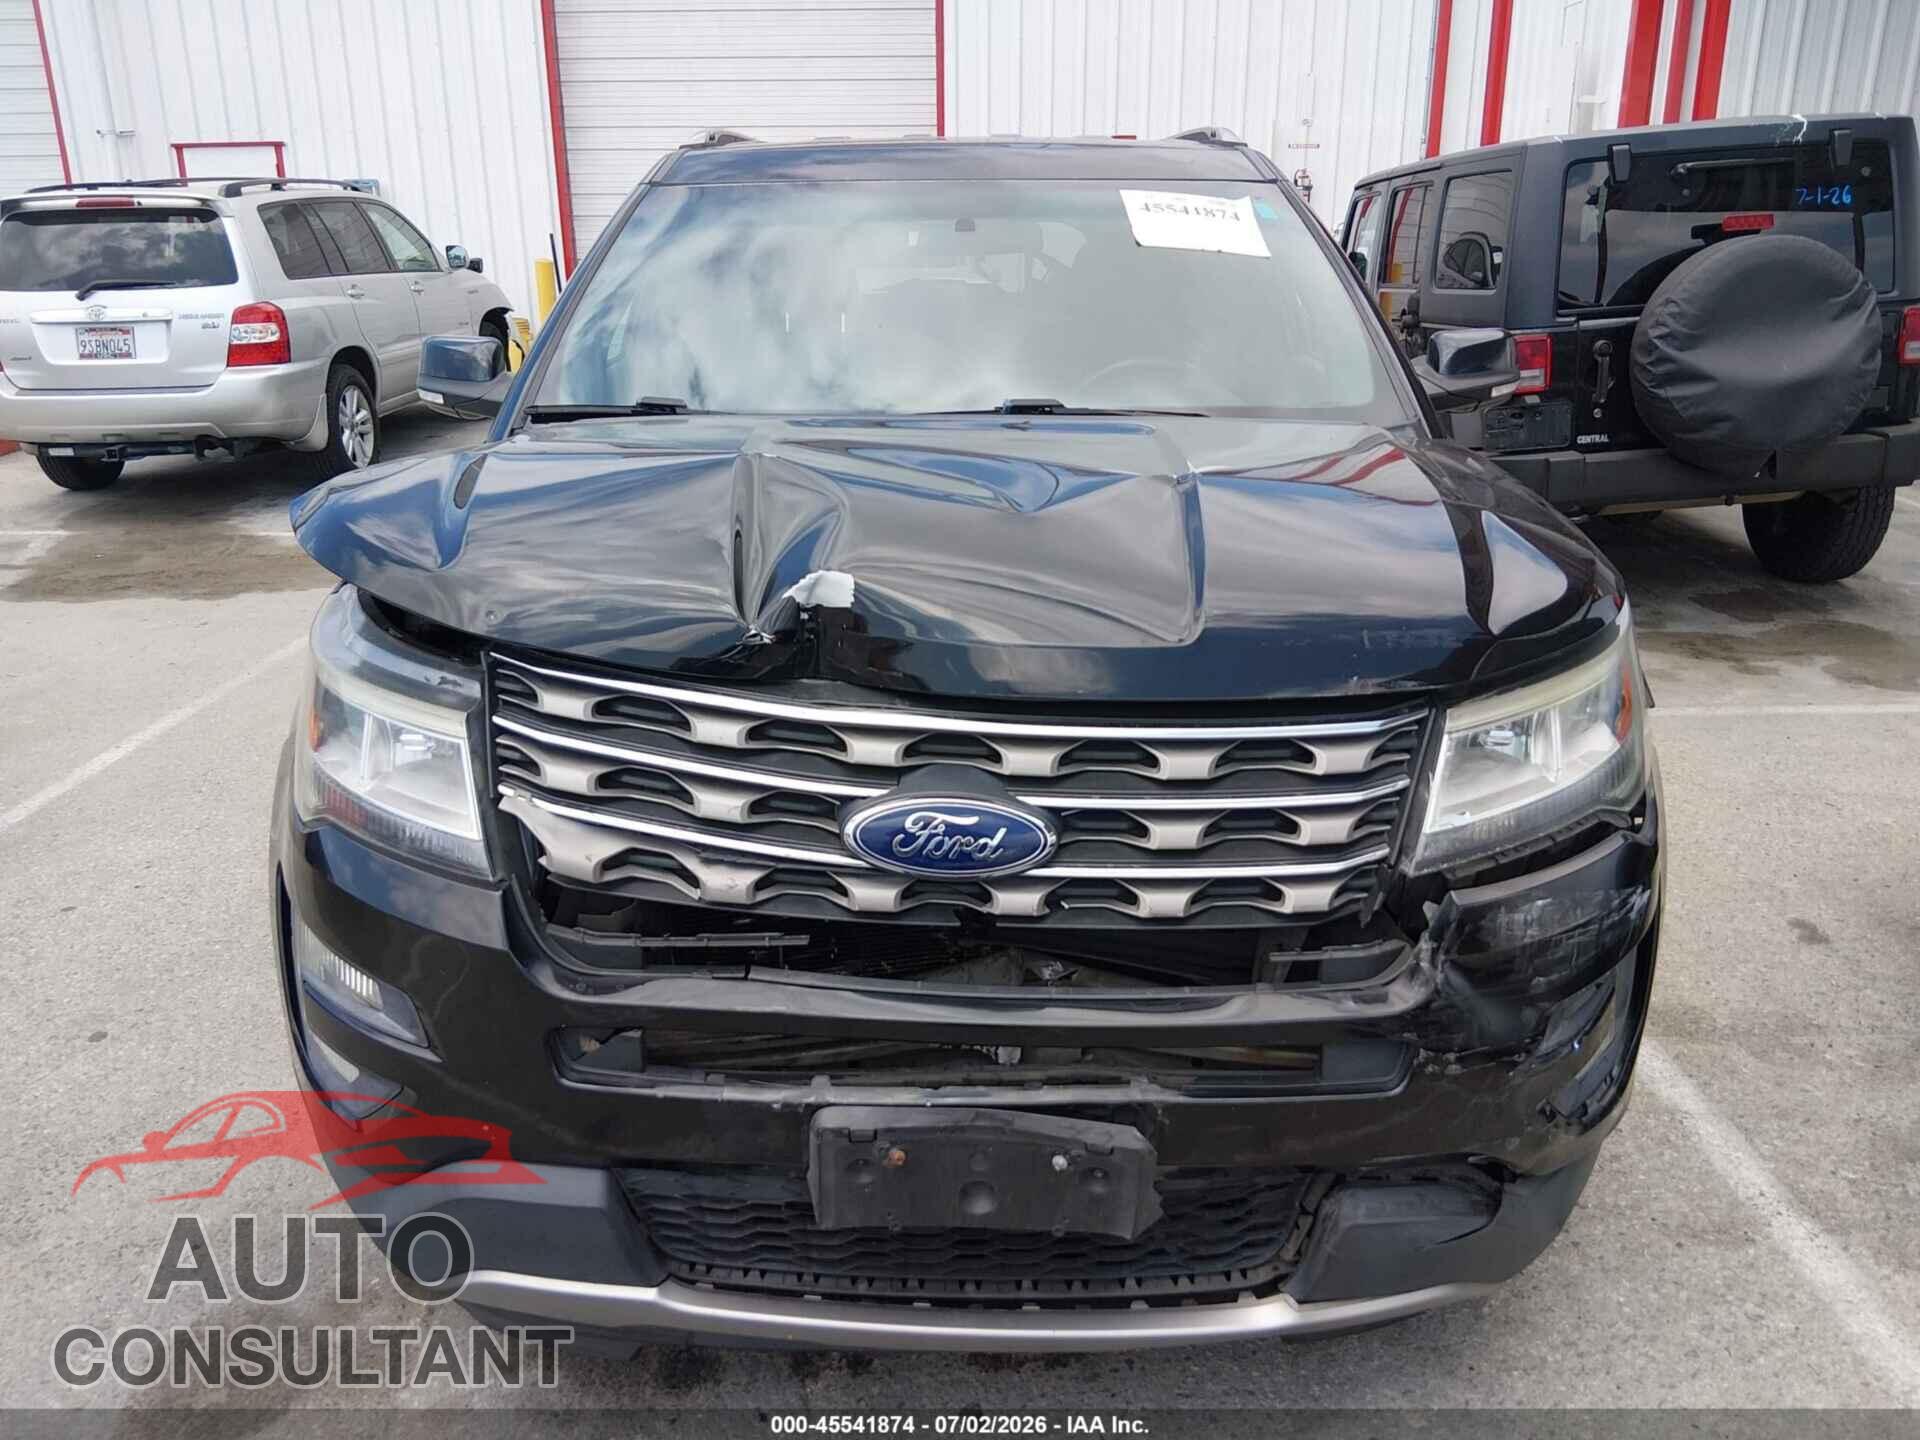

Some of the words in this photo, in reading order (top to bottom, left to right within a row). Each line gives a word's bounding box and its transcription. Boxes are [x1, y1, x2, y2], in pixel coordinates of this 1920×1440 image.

[1794, 184, 1852, 205] 7-1-26
[1576, 433, 1609, 444] CENTRAL
[892, 811, 1008, 861] Ford
